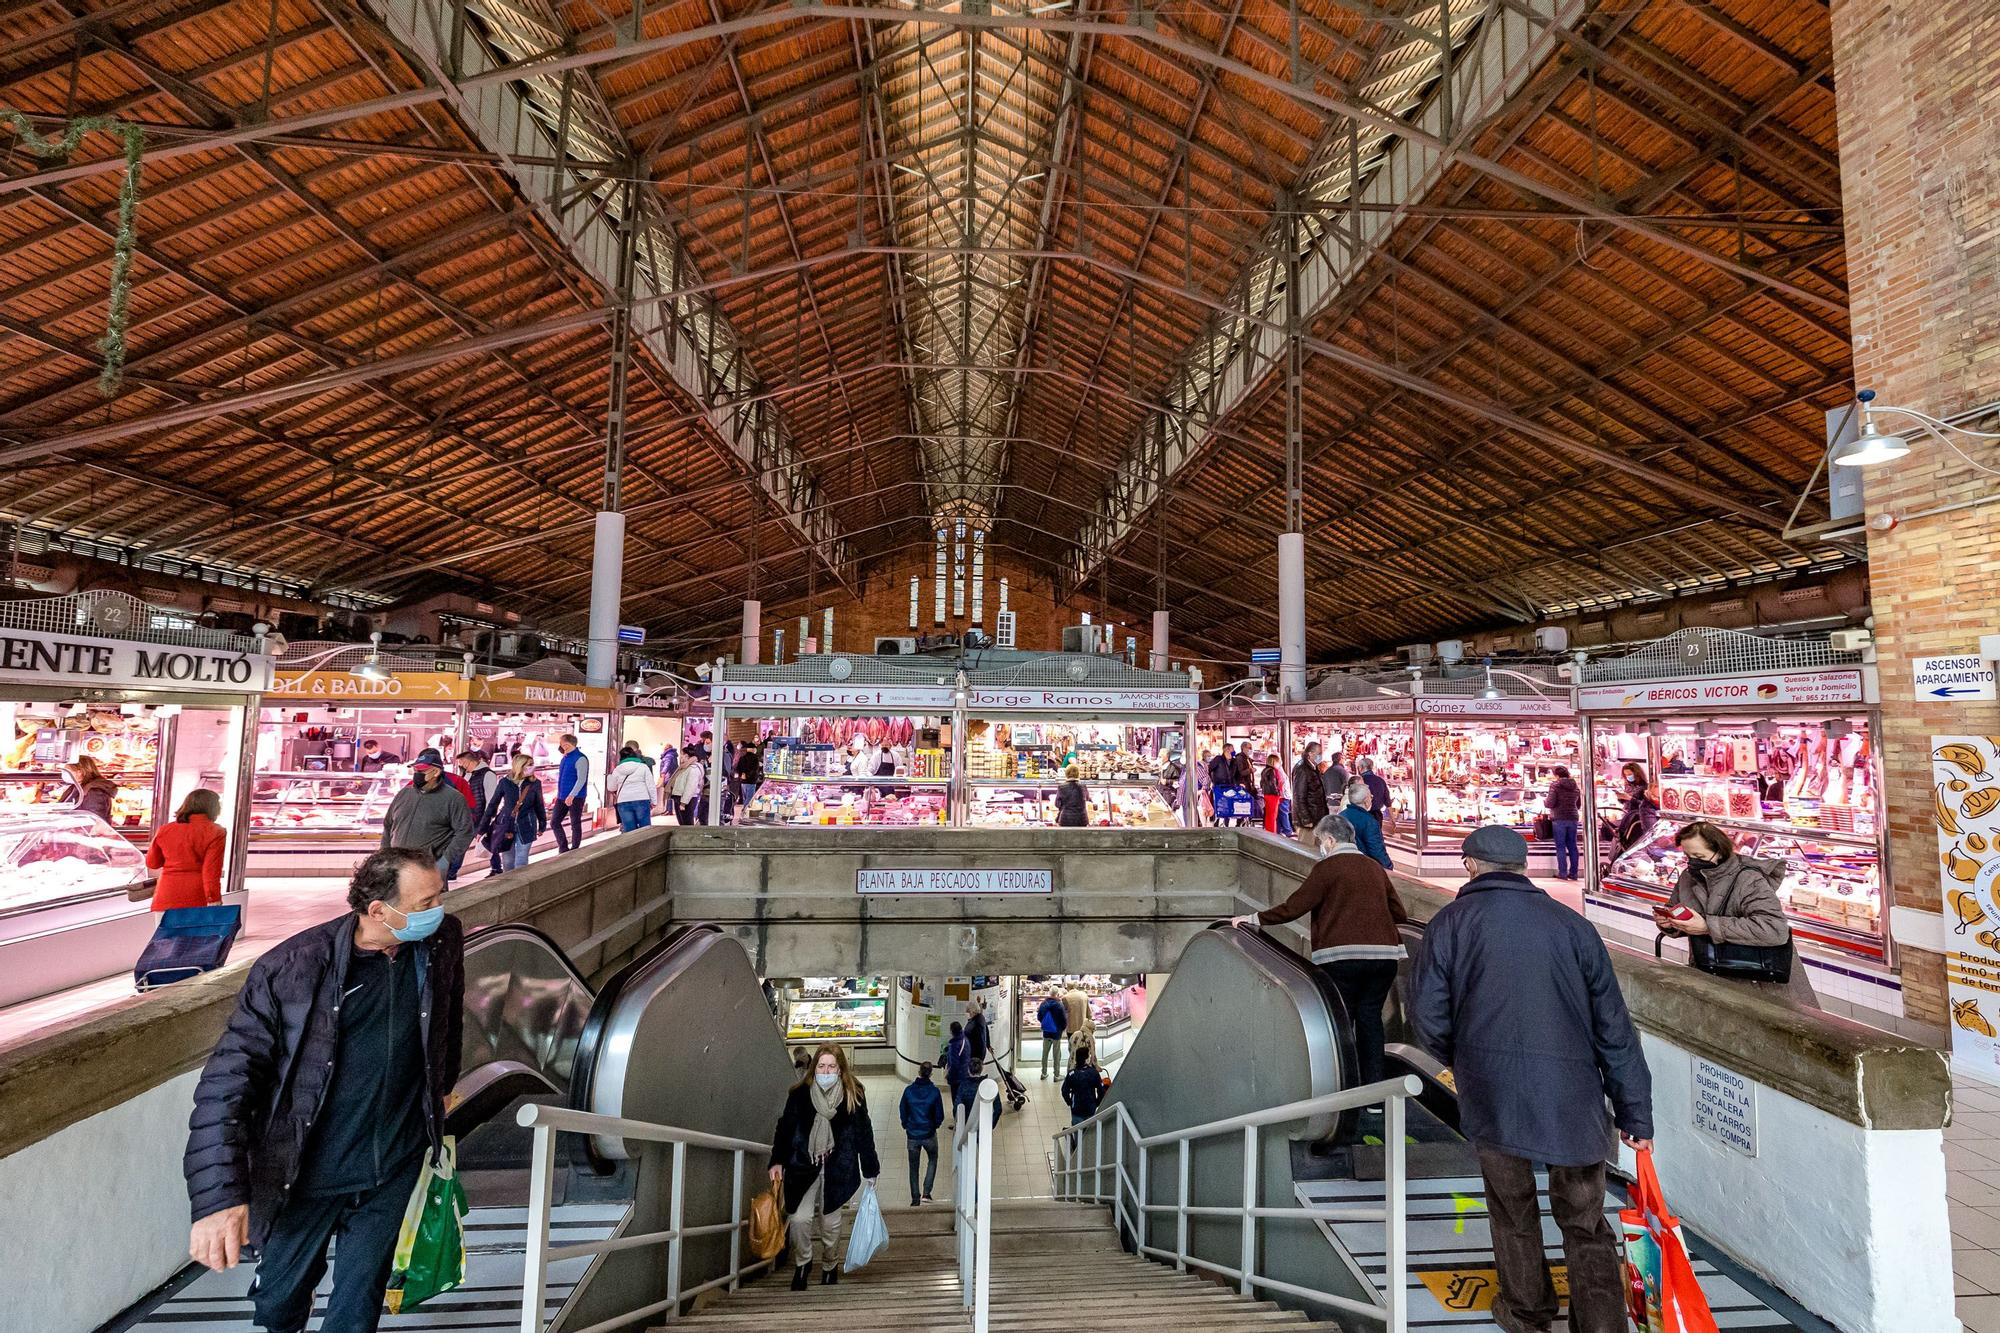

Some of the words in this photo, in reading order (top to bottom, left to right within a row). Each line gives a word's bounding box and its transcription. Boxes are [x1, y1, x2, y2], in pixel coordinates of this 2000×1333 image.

[104, 607, 121, 622] 22
[1687, 643, 1700, 657] 23
[0, 637, 114, 676] ENTE
[132, 650, 252, 684] MOLTÓ
[1925, 658, 1981, 672] ASCENSOR
[835, 664, 846, 673] 98
[1072, 666, 1083, 674] 99
[1818, 673, 1857, 681] Salazones
[1916, 671, 1994, 685] APARCAMIENTO
[312, 678, 326, 695] &
[330, 676, 402, 695] BALDÓ
[1821, 683, 1857, 691] Domicilio
[971, 692, 1031, 706] Jorge
[1043, 692, 1113, 705] Ramos
[1120, 692, 1170, 700] JAMONES
[1647, 687, 1698, 701] IBÉRICOS
[1704, 685, 1749, 698] VICTOR
[1132, 701, 1191, 709] EMBUTIDOS
[1420, 700, 1466, 713] Gómez
[1475, 702, 1503, 711] QUESOS
[1520, 703, 1551, 712] JAMONES
[860, 872, 896, 889] PLANTA
[901, 872, 924, 889] BAJA
[930, 873, 980, 889] PESCADOS
[986, 873, 993, 888] Y
[997, 873, 1046, 889] VERDURAS
[1961, 976, 1976, 986] de
[1700, 1062, 1744, 1090] PROHIBIDO
[1696, 1073, 1720, 1092] SUBIR
[1723, 1087, 1735, 1100] EN
[1738, 1093, 1750, 1108] LA
[1701, 1089, 1744, 1119] ESCALERA
[1696, 1100, 1713, 1117] CON
[1717, 1111, 1751, 1137] CARROS
[1696, 1113, 1705, 1127] DE
[1708, 1120, 1718, 1134] LA
[1720, 1127, 1752, 1152] COMPRA
